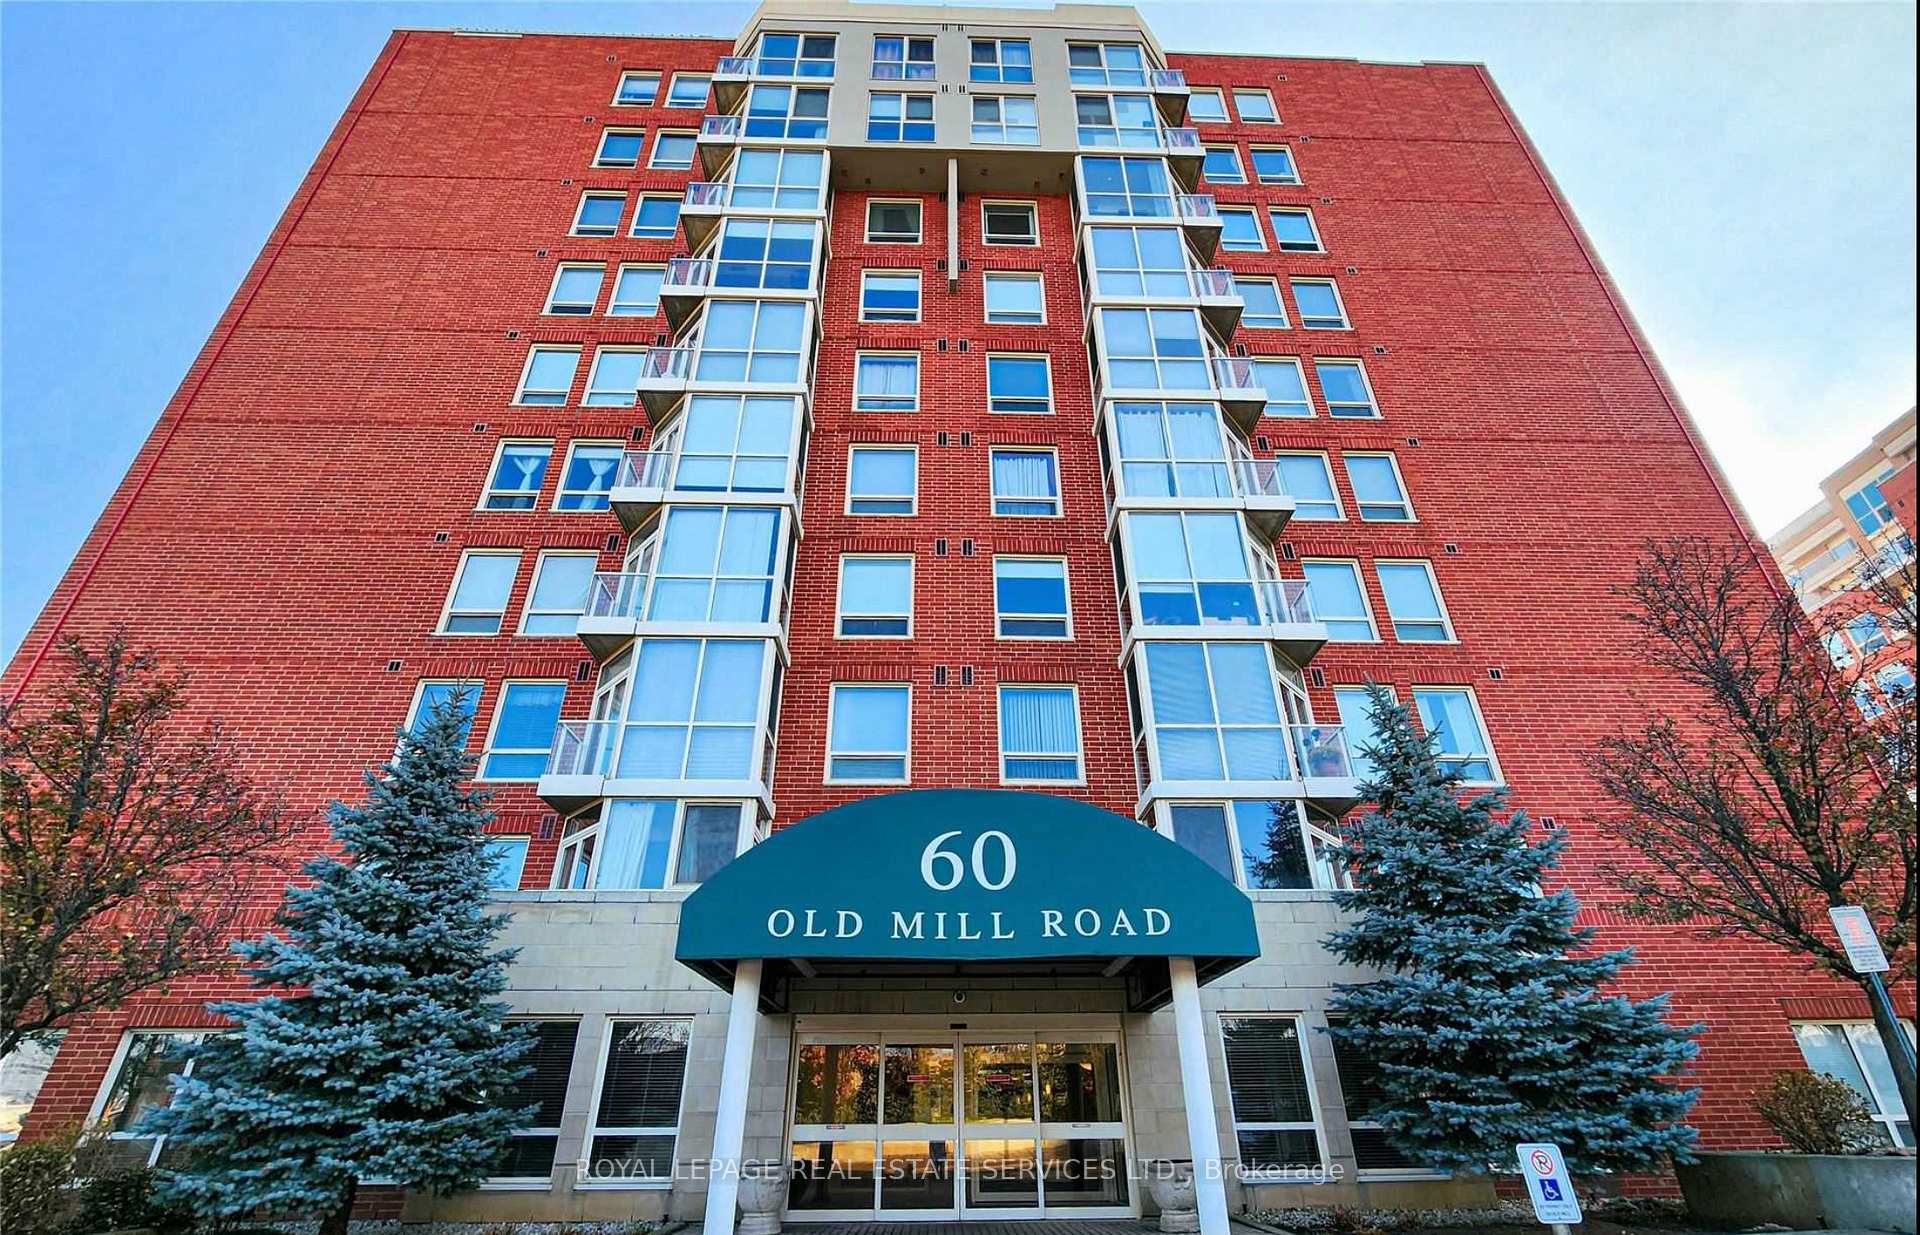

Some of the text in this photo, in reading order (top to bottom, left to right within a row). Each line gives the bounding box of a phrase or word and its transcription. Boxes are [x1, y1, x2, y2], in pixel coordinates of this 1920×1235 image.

[920, 830, 1018, 891] 60
[767, 908, 1171, 940] OLD MILL ROAD
